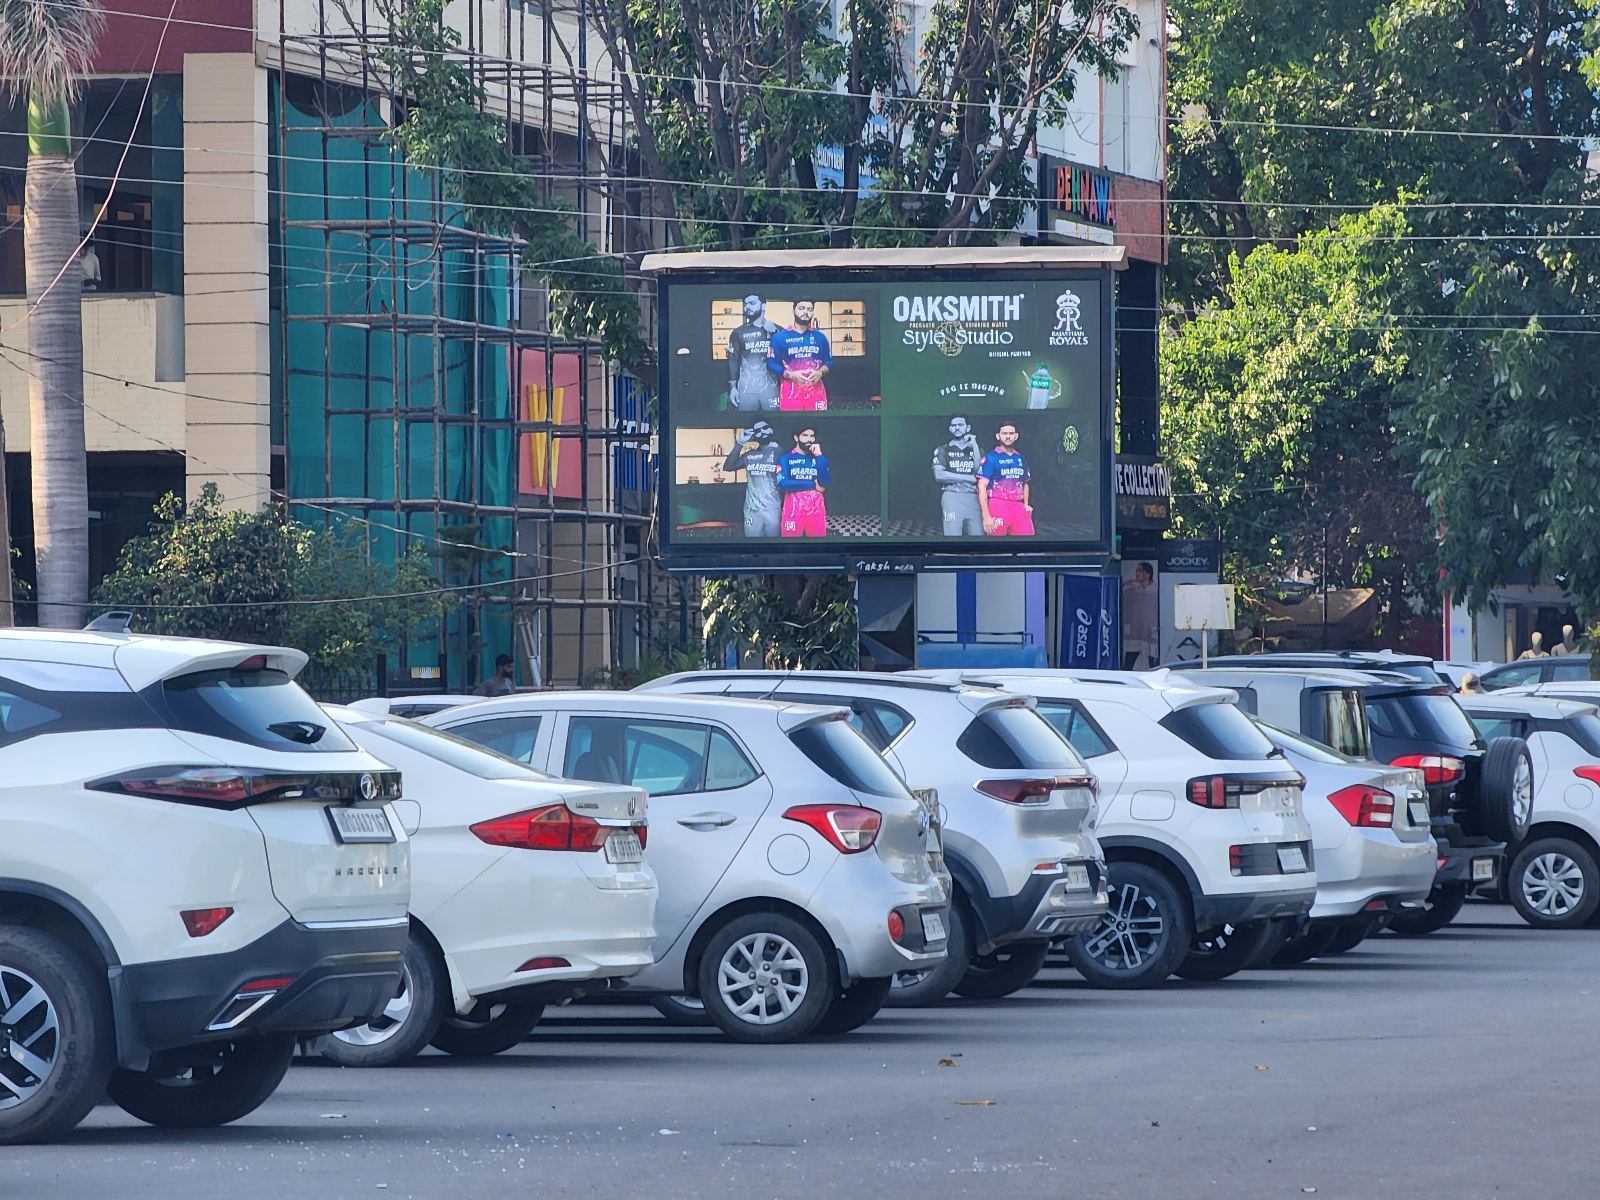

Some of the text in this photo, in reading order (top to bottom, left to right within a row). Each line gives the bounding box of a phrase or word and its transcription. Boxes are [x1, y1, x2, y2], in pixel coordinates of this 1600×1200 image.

[1056, 165, 1117, 227] PEHNAWA
[893, 295, 1020, 323] OAKSMITH
[902, 328, 1014, 353] Style Studio
[1049, 336, 1089, 346] ROYALS
[1123, 463, 1172, 497] COLLECTION
[855, 560, 891, 572] Taksh
[1166, 557, 1209, 567] JOCKEY
